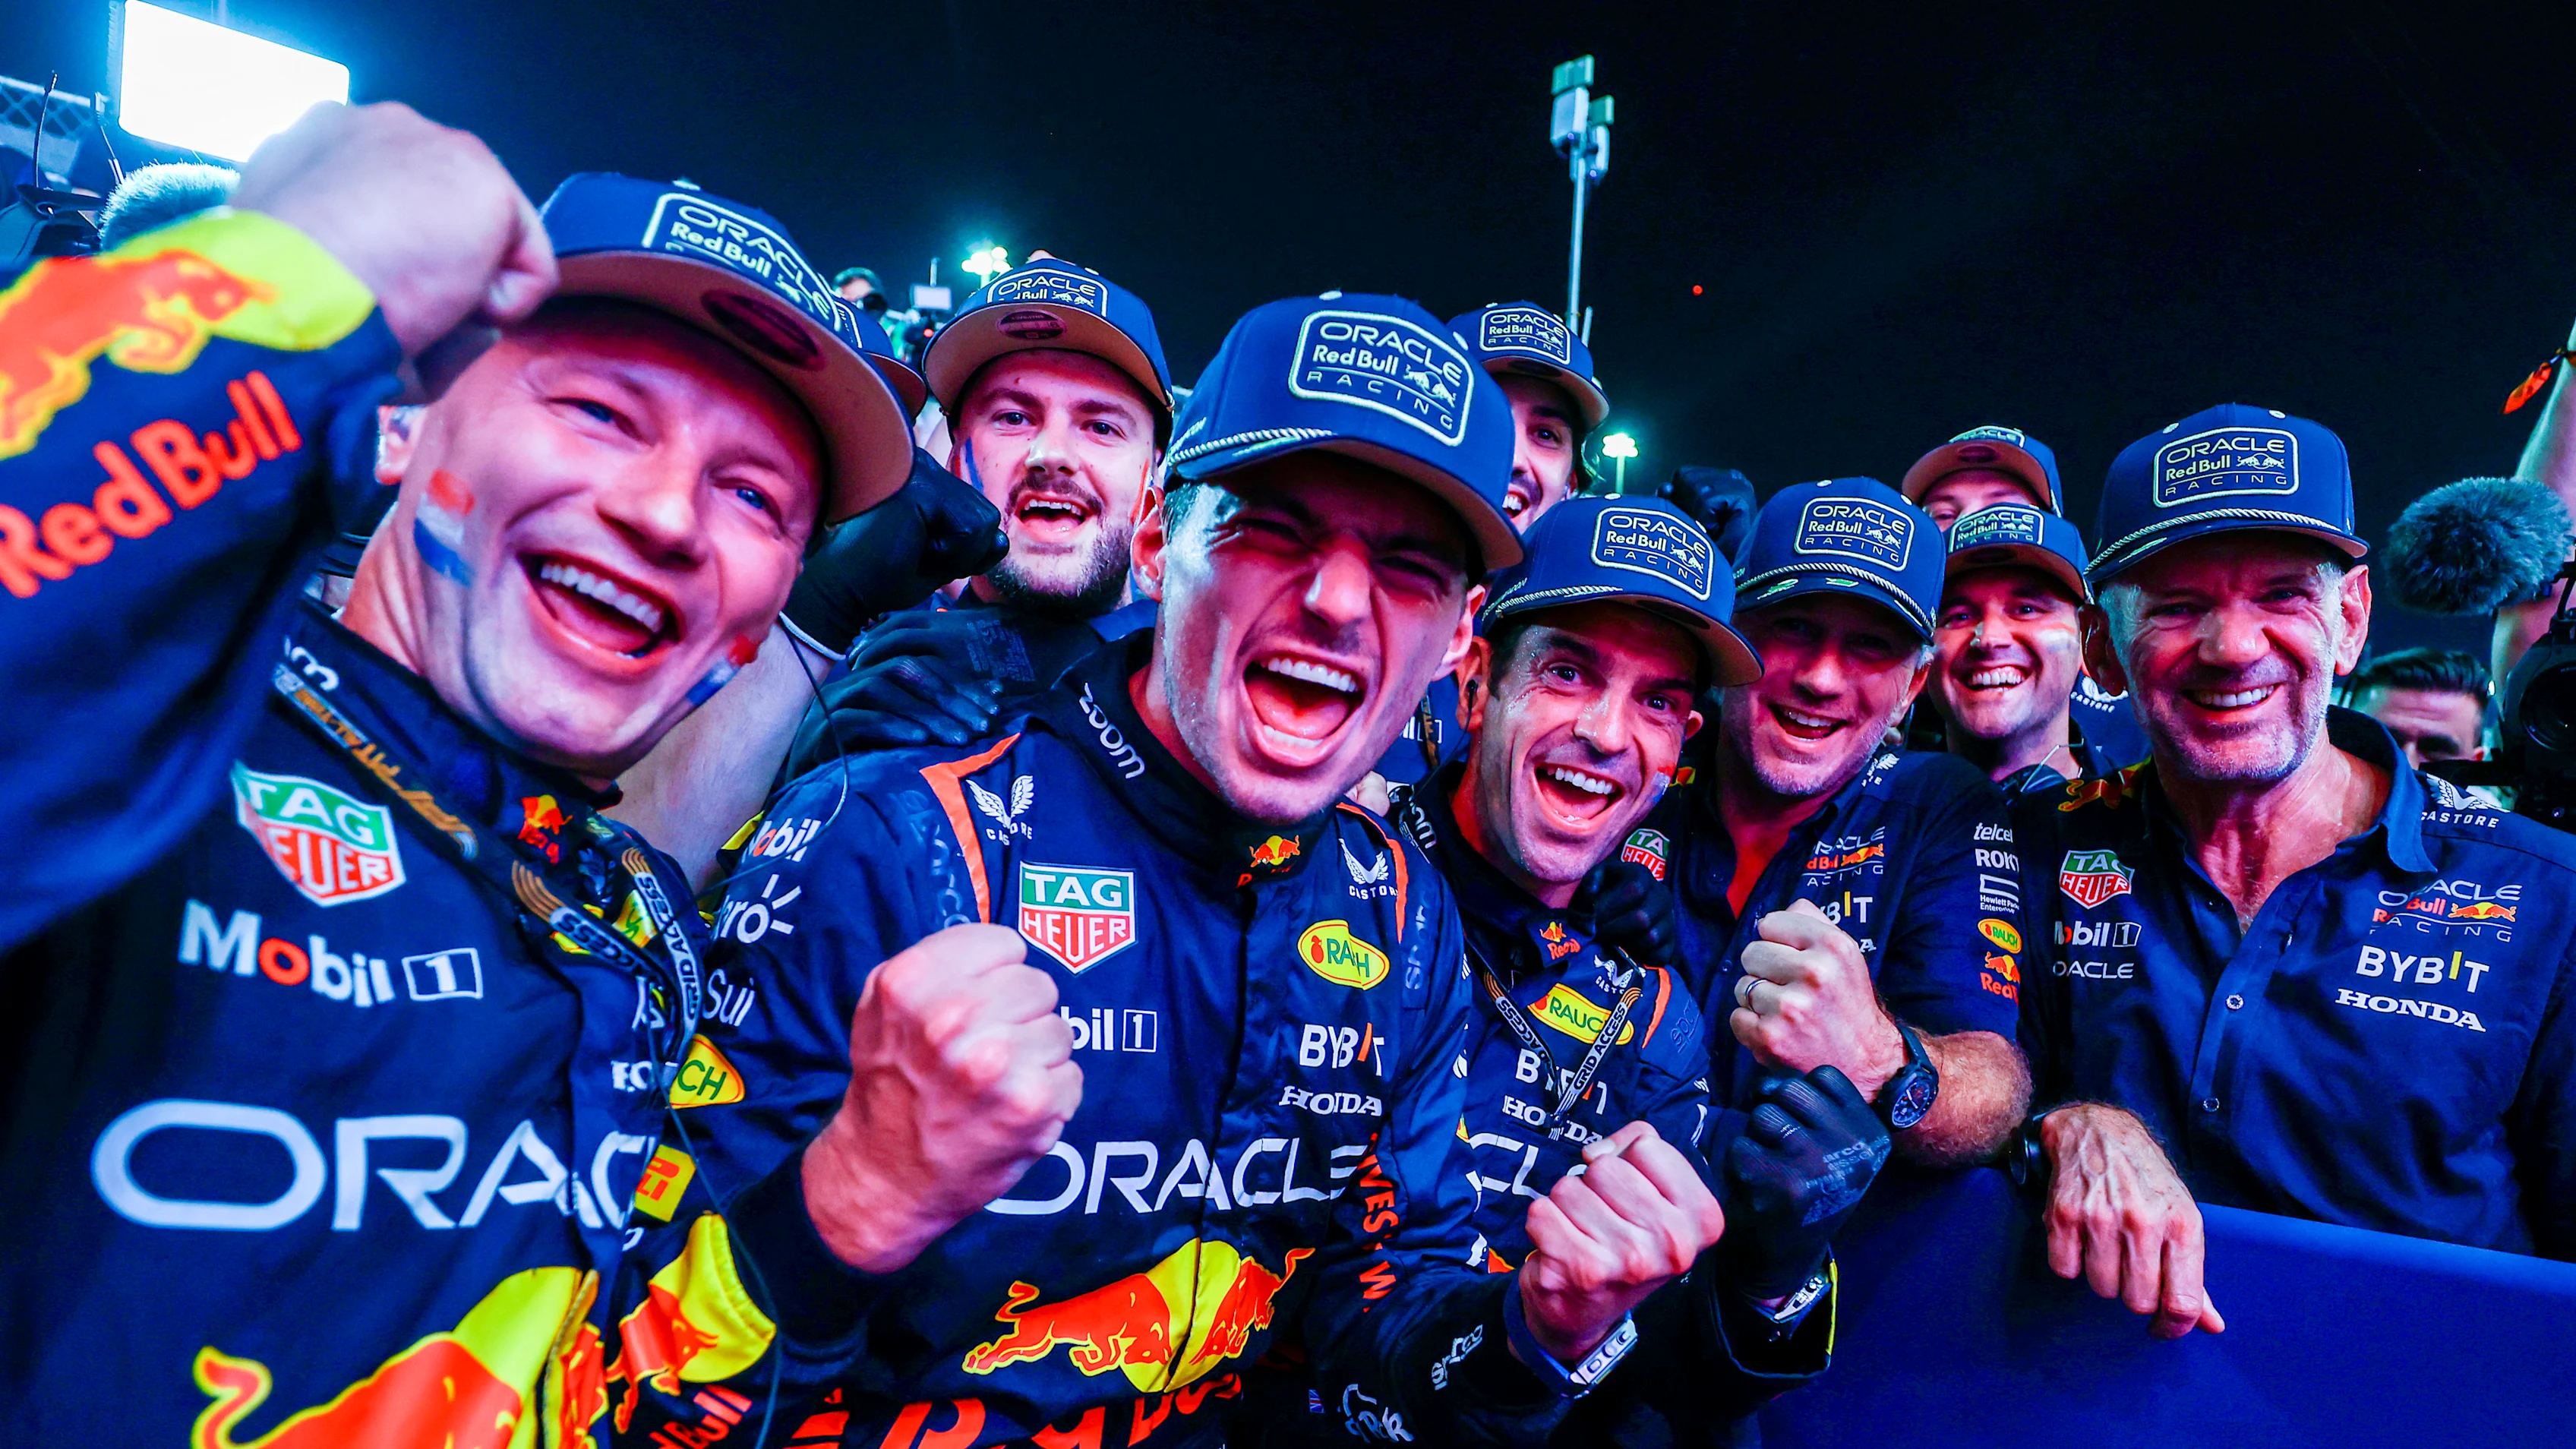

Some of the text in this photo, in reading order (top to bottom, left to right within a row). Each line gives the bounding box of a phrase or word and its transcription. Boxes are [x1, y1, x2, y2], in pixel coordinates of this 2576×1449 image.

[671, 221, 772, 278] Red Bull
[679, 205, 829, 320] ORACLE
[999, 275, 1096, 297] ORACLE
[1489, 324, 1533, 335] Red Bull
[1490, 314, 1564, 339] ORACLE
[1312, 345, 1399, 377] Red Bull
[1319, 321, 1463, 387] ORACLE
[1488, 336, 1564, 358] RACING
[1306, 370, 1453, 431] RACING
[130, 370, 303, 510] Bull
[2167, 437, 2286, 465] ORACLE
[2165, 454, 2230, 481] Red Bull
[2165, 475, 2287, 497] RACING
[1608, 515, 1706, 560] ORACLE
[1808, 519, 1863, 535] Red Bull
[1813, 505, 1906, 535] ORACLE
[1958, 511, 2035, 532] ORACLE
[1978, 521, 1998, 535] Bull
[1606, 530, 1667, 552] Red Bull
[1804, 537, 1899, 564] RACING
[1603, 548, 1703, 589] RACING
[1078, 682, 1145, 779] zoom
[246, 777, 375, 846] TAG
[1637, 831, 1664, 857] TA
[1812, 826, 1886, 855] RACLE
[266, 828, 396, 895] EUER
[1807, 863, 1884, 887] ACING
[1024, 871, 1122, 908] TAG
[2062, 873, 2128, 904] HEUER
[1823, 890, 1874, 926] BIT
[2406, 898, 2446, 916] Bull
[1024, 911, 1127, 964] HEUER
[1992, 926, 2018, 949] RAUCH
[2370, 917, 2512, 942] ACING
[177, 898, 458, 1008] Mobil 1
[2052, 960, 2135, 979] OACLE
[2356, 945, 2489, 993] BYBIT
[702, 968, 756, 1028] Sui
[1549, 996, 1606, 1034] RAUC
[2335, 988, 2486, 1032] HONDA
[1060, 1005, 1143, 1051] bil 1
[1498, 999, 1542, 1052] ACCESS
[1299, 1022, 1385, 1076] BYBIT
[1574, 1005, 1627, 1091] GRID ACCESS
[1502, 1094, 1605, 1145] HODA
[90, 1097, 656, 1231] ORAC
